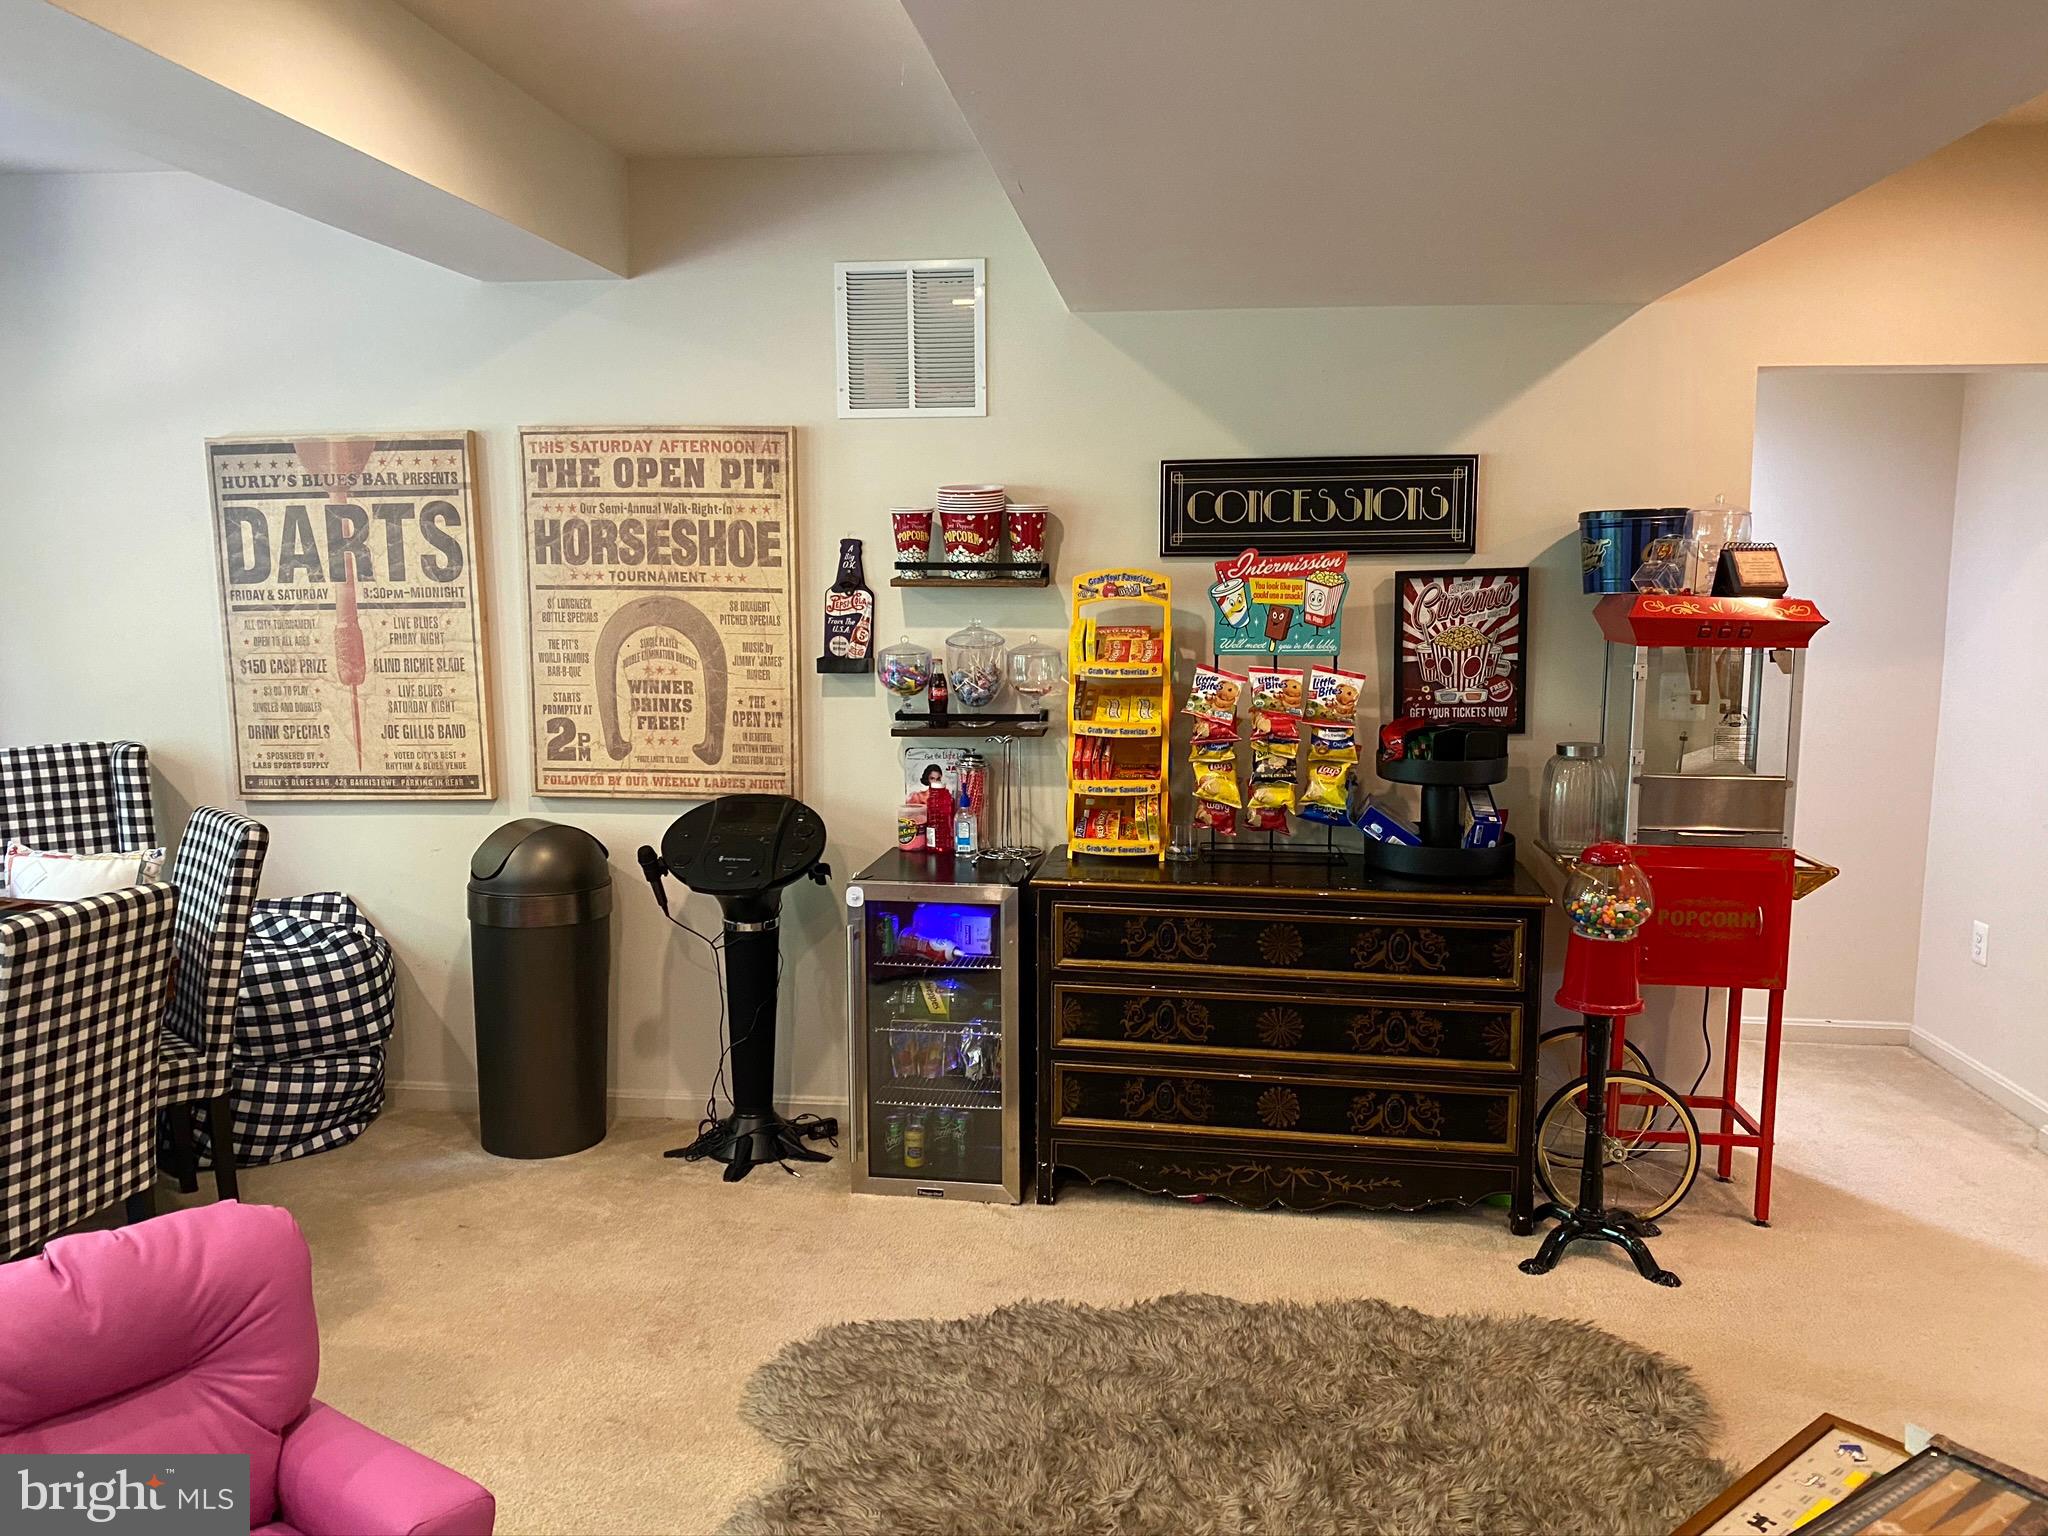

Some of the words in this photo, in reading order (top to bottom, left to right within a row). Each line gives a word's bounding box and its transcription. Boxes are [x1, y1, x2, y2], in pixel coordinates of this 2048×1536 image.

[529, 441, 565, 454] THIS
[571, 440, 653, 453] SATURDAY
[659, 440, 755, 454] AFTERNOON
[761, 441, 780, 454] AT
[530, 458, 600, 489] THE
[613, 457, 705, 489] OPEN
[720, 458, 779, 489] PIT
[222, 475, 297, 489] HURLY'S
[302, 473, 357, 487] BLUES
[363, 472, 398, 485] BAR
[403, 471, 458, 485] PRESENTS
[580, 503, 598, 515] Our
[599, 502, 662, 515] Semi-Annual
[663, 503, 732, 517] Walk-Right-In
[1187, 486, 1449, 524] CONCESSIONS
[223, 500, 463, 585] DARTS
[534, 518, 782, 568] HORSESHOE
[898, 530, 929, 543] POPCORN
[944, 530, 980, 545] POPCORN
[1227, 552, 1343, 578] Intermission
[609, 570, 707, 584] TOURNAMENT
[1088, 576, 1105, 585] Grab
[1121, 573, 1153, 585] Favorites
[1255, 581, 1265, 589] You
[1267, 581, 1279, 589] look
[1292, 584, 1303, 592] you
[230, 589, 265, 601] FRIDAY
[267, 590, 275, 601] &
[277, 588, 328, 600] SATURDAY
[740, 601, 770, 613] DRAUGHT
[1411, 582, 1513, 630] Cinema
[393, 617, 411, 629] LIVE
[413, 616, 439, 629] BLUES
[541, 612, 566, 623] BOTTLE
[567, 612, 599, 623] SPECIALS
[720, 615, 748, 626] PITCHER
[749, 615, 781, 627] SPECIALS
[389, 632, 417, 645] FRIDAY
[420, 632, 445, 645] NIGHT
[548, 639, 560, 650] THE
[1303, 639, 1315, 649] the
[742, 642, 764, 653] MUSIC
[765, 642, 774, 655] by
[563, 652, 590, 664] FAMOUS
[240, 659, 267, 674] $150
[270, 659, 297, 674] CASH
[300, 658, 328, 674] PRIZE
[373, 658, 401, 673] BLIND
[404, 657, 435, 673] RICHIE
[437, 657, 466, 672] SLADE
[1120, 668, 1149, 676] Favorites
[628, 680, 695, 695] WINNER
[1200, 681, 1224, 691] Bites
[1266, 680, 1288, 690] Bites
[1313, 677, 1337, 690] Little
[293, 685, 309, 696] PLAY
[398, 685, 415, 698] LIVE
[418, 684, 443, 697] BLUES
[1318, 687, 1343, 698] Bites
[553, 692, 581, 703] STARTS
[749, 695, 766, 709] THE
[280, 702, 294, 713] AND
[388, 700, 428, 713] SATURDAY
[431, 700, 456, 713] NIGHT
[543, 705, 582, 715] PROMPTLY
[583, 705, 593, 715] AT
[631, 698, 693, 713] DRINKS
[1410, 707, 1425, 718] GET
[1428, 707, 1450, 718] YOUR
[1452, 707, 1486, 718] TICKETS
[1488, 706, 1508, 718] NOW
[732, 711, 761, 728] OPEN
[765, 711, 784, 728] PIT
[248, 725, 280, 740] DRINK
[282, 724, 330, 740] SPECIALS
[381, 724, 400, 740] JOE
[402, 724, 435, 739] GILLIS
[437, 724, 466, 739] BAND
[1104, 727, 1118, 735] Your
[1120, 727, 1148, 735] Favorites
[546, 717, 577, 761] 2
[306, 752, 315, 760] BY
[394, 752, 415, 760] VOTED
[417, 751, 438, 760] CITY'S
[440, 751, 457, 760] BEST
[385, 762, 413, 770] RHYTHM
[423, 762, 443, 770] BLUES
[445, 761, 467, 770] VENUE
[1318, 765, 1341, 776] Lay's
[401, 779, 433, 787] PARKING
[444, 779, 464, 787] REAR
[543, 775, 604, 786] FOLLOWED
[608, 775, 621, 786] BY
[626, 775, 649, 786] OUR
[652, 776, 700, 787] WEEKLY
[704, 777, 746, 789] LADIES
[749, 779, 786, 790] NIGHT
[1119, 786, 1148, 794] Favorites
[1657, 909, 1757, 928] POPCORN
